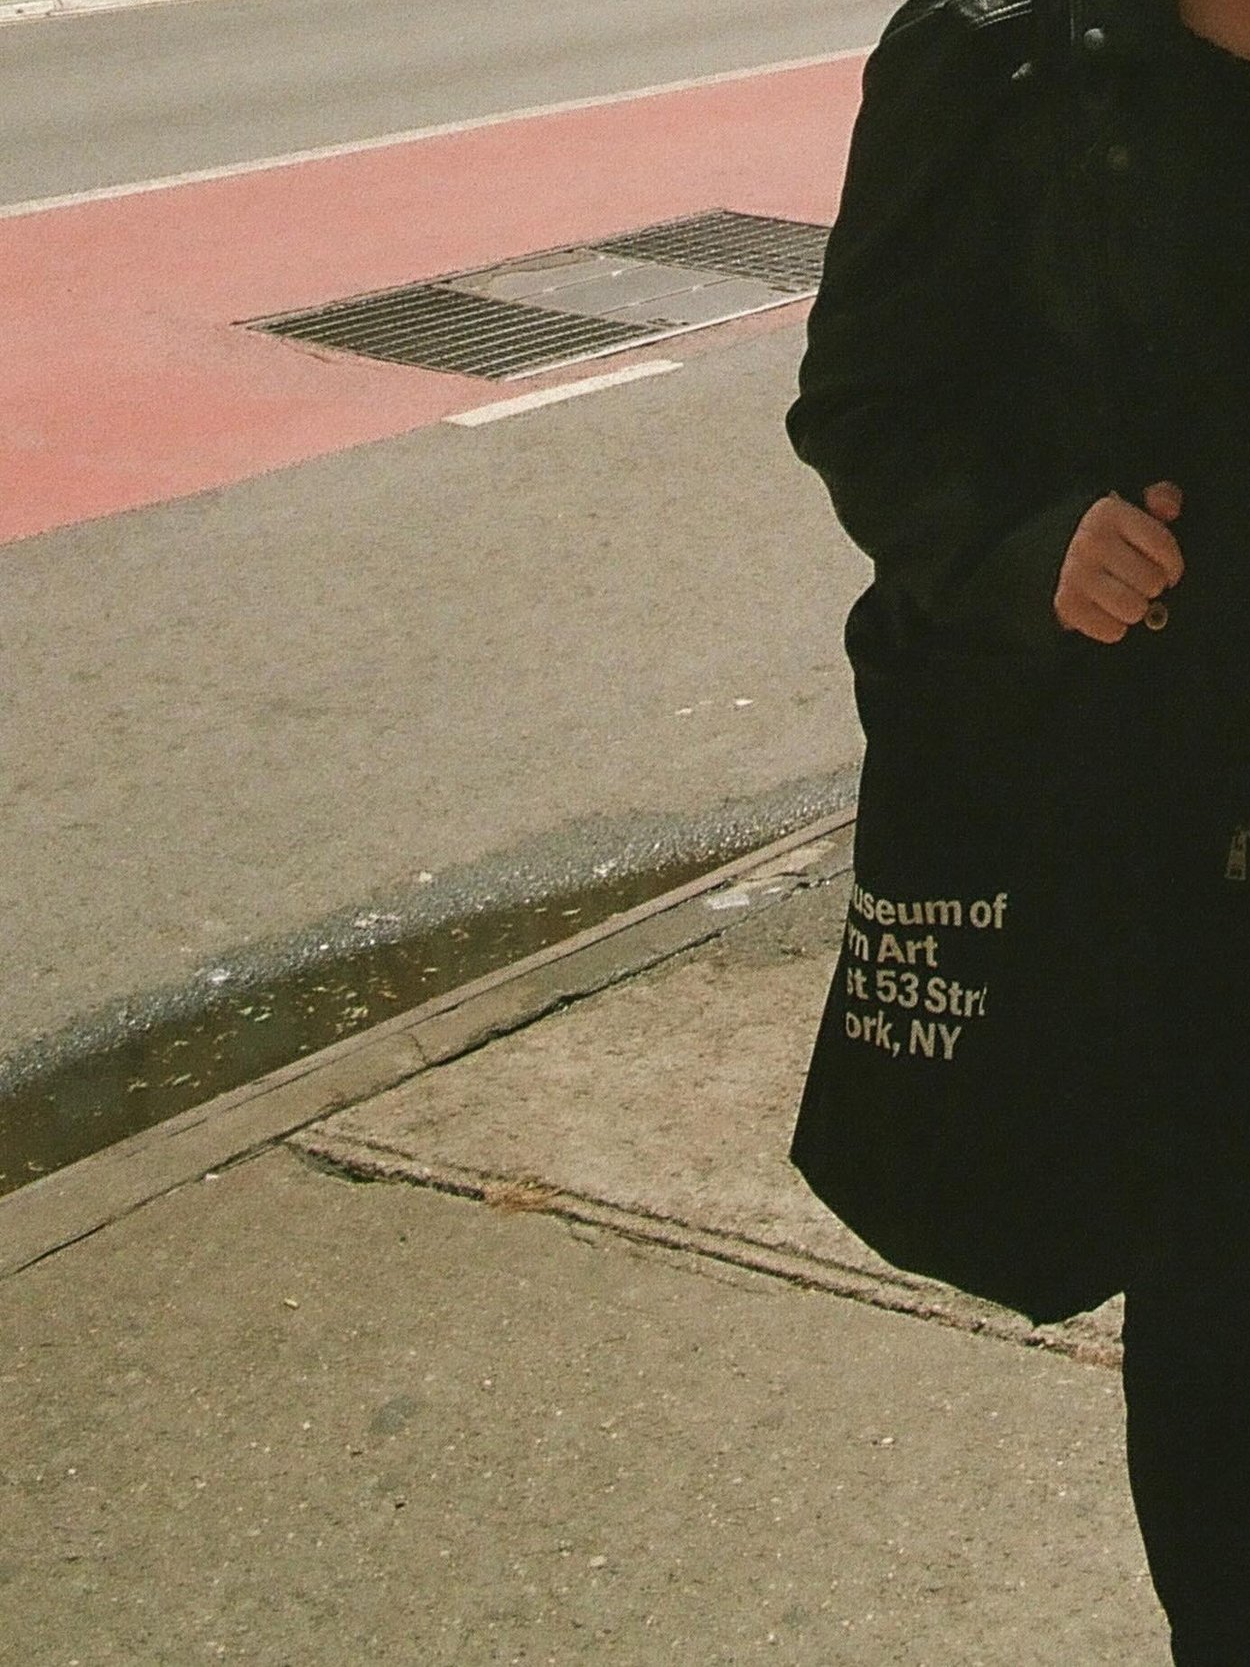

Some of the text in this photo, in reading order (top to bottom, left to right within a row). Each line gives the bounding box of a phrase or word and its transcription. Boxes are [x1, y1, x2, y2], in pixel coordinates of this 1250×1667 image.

[968, 891, 1009, 929] of
[876, 933, 939, 969] Art
[875, 969, 920, 1009] 53
[845, 1009, 963, 1061] ork, NY
